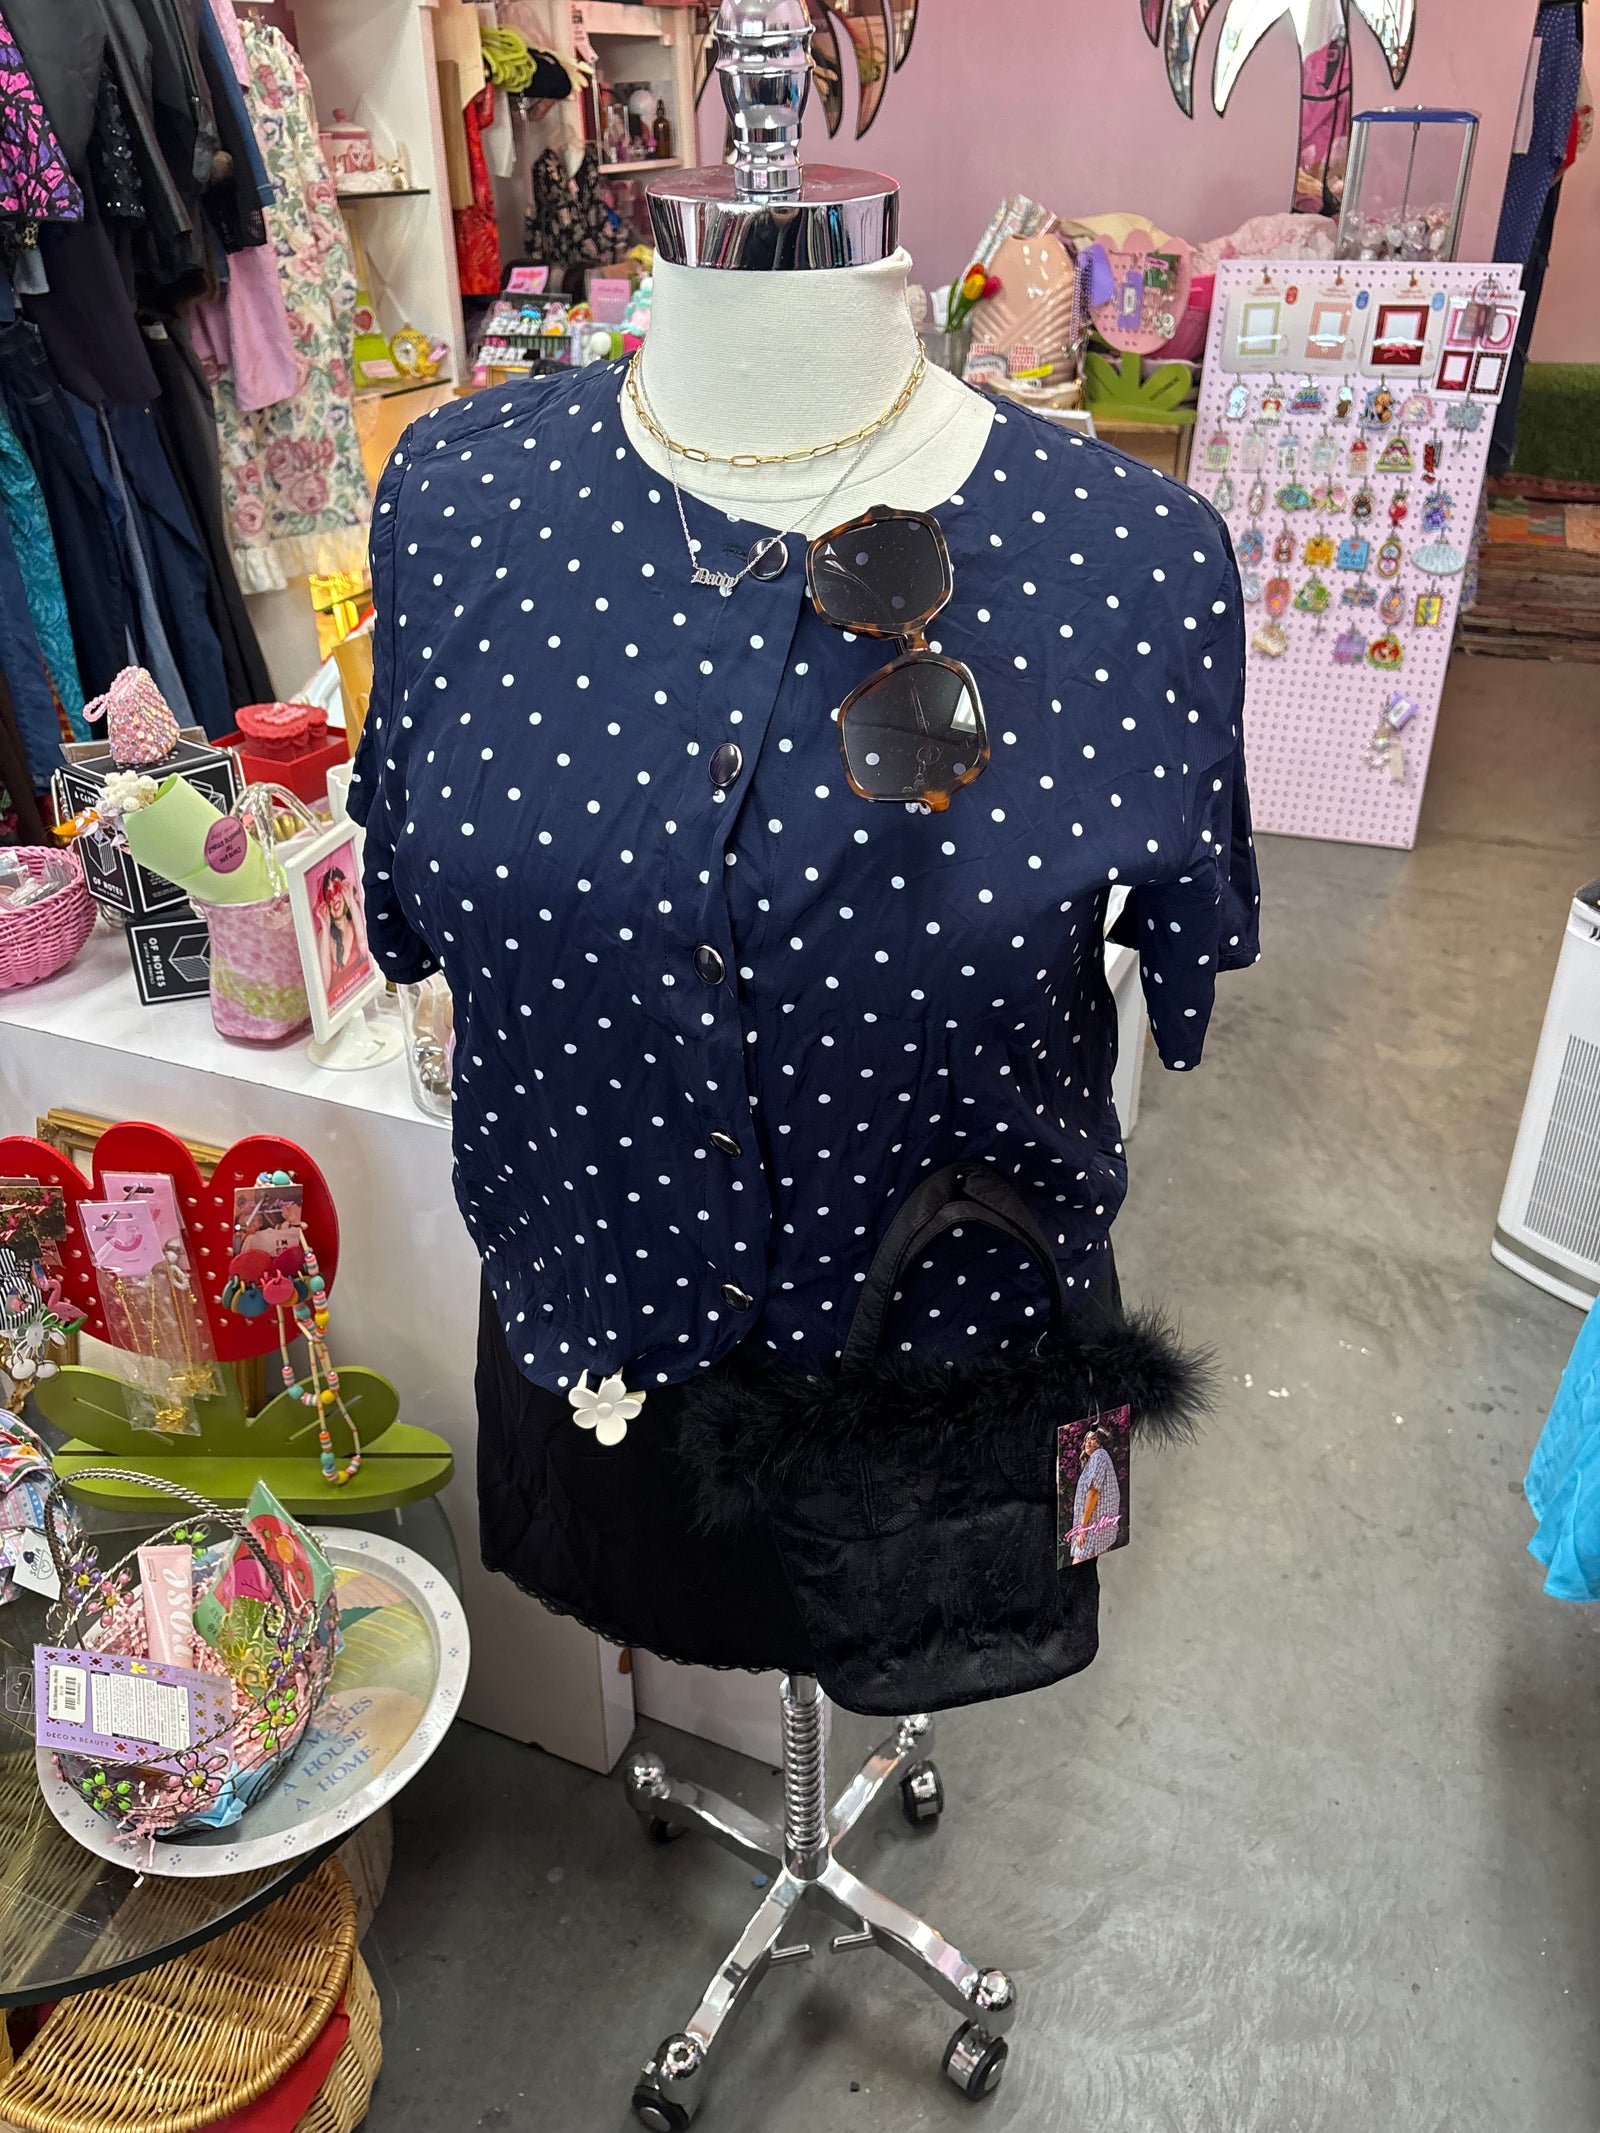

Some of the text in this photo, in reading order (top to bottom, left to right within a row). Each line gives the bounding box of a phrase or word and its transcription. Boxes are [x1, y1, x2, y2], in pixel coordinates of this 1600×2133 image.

[690, 568, 740, 589] Daddy
[92, 876, 102, 886] OF
[103, 880, 124, 896] NOTES
[148, 937, 167, 987] OF NOTES
[161, 1567, 195, 1657] rose
[46, 1731, 109, 1747] DECO BEAUTY
[283, 1726, 368, 1797] A HOUSE
[295, 1744, 380, 1812] A HOME.
